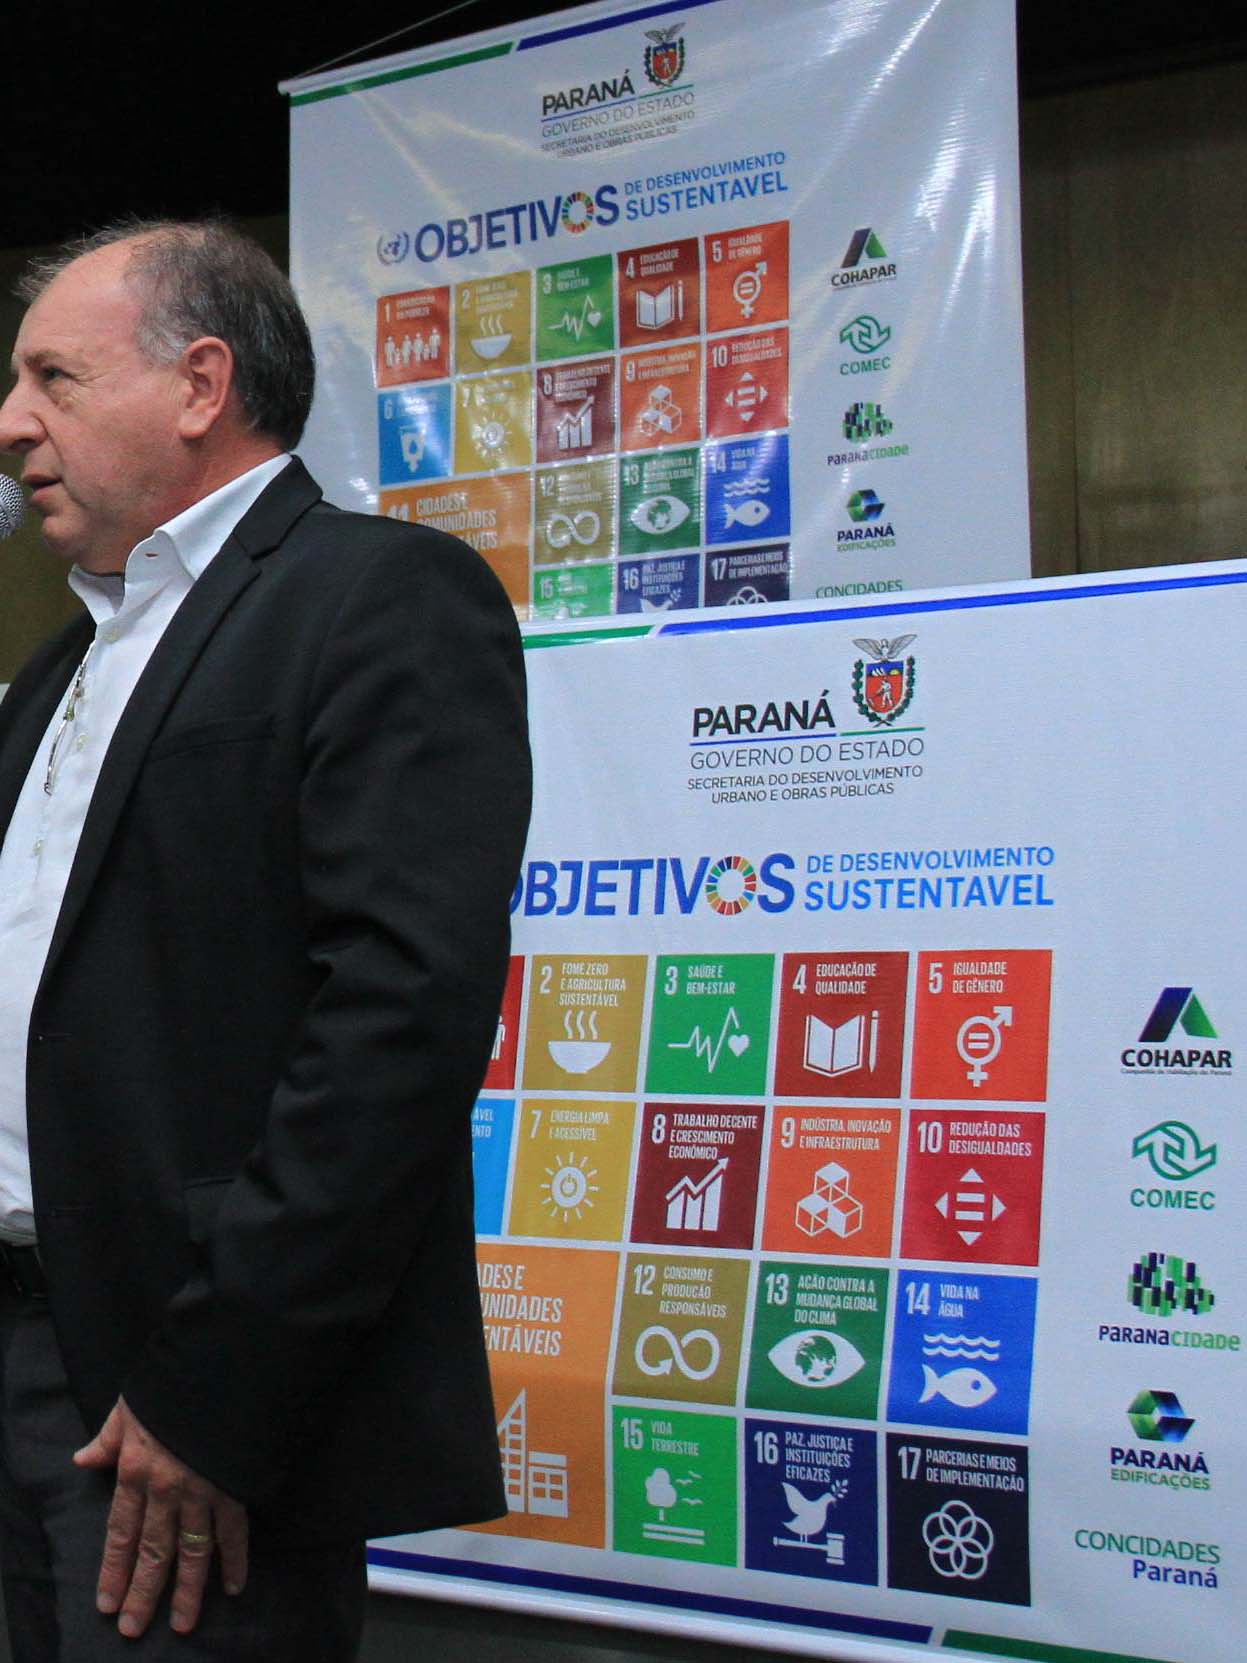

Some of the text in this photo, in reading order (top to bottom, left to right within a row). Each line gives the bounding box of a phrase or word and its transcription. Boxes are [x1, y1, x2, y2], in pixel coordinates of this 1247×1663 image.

[543, 69, 635, 116] PARANÁ
[542, 112, 609, 138] GOVERNO
[613, 106, 634, 121] DO
[638, 92, 694, 116] ESTADO
[624, 152, 786, 196] DE DESENVOLVIMENTO
[625, 172, 789, 220] SUSTENTAVEL
[414, 185, 621, 263] OBJETIVOS
[712, 240, 722, 262] 5
[625, 257, 635, 279] 4
[831, 264, 896, 286] COHAPAR
[543, 273, 551, 294] 3
[462, 290, 470, 308] 2
[712, 345, 728, 367] 10
[840, 357, 891, 375] COMEC
[626, 361, 636, 381] 9
[543, 374, 552, 395] 8
[624, 464, 639, 485] 13
[837, 522, 894, 541] PARANÁ
[624, 568, 639, 590] 16
[712, 558, 727, 580] 17
[816, 579, 903, 598] CONCIDADES
[693, 689, 836, 737] PARANÁ
[690, 737, 924, 770] GOVERNO DO ESTADO
[687, 765, 923, 789] SECRETARIA DO DESENVOLVIMENTO
[711, 783, 894, 804] URBANO E OBRAS PÚBLICAS
[806, 846, 1055, 873] DE DESENVOLVIMENTO
[804, 873, 1055, 911] SUSTENTAVEL
[562, 963, 609, 975] FOME ZERO
[687, 965, 723, 977] SAÚDE E
[793, 964, 807, 994] 4
[816, 961, 876, 977] EDUCAÇÃO DE
[929, 963, 944, 993] 5
[953, 961, 1007, 976] IGUALDADE
[540, 965, 552, 994] 2
[560, 978, 626, 990] E AGRICULTURA
[664, 966, 678, 995] 3
[686, 982, 736, 995] BEM-ESTAR
[815, 981, 867, 994] QUALIDADE
[952, 978, 1003, 993] DE GÊNERO
[559, 991, 619, 1006] SUSTENTÁVEL
[1121, 1049, 1232, 1068] COHAPAR
[530, 1110, 542, 1139] 7
[583, 1111, 610, 1125] LIMPA
[673, 1113, 758, 1128] TRABALHO DECENTE
[847, 1119, 892, 1134] INOVAÇÃO
[652, 1114, 666, 1144] 8
[670, 1130, 735, 1144] E CRESCIMENTO
[781, 1117, 796, 1148] 9
[918, 1121, 942, 1153] 10
[950, 1121, 1020, 1138] REDUÇÃO DAS
[669, 1145, 718, 1160] ECONÔMICO
[799, 1136, 879, 1150] E INFRAESTRUTURA
[949, 1140, 1031, 1157] DESIGUALDADES
[1130, 1188, 1216, 1211] COMEC
[514, 1265, 525, 1291] E
[634, 1264, 656, 1296] 12
[663, 1266, 713, 1281] CONSUMO E
[798, 1274, 875, 1293] AÇÃO CONTRA A
[662, 1284, 711, 1300] PRODUÇÃO
[765, 1272, 789, 1306] 13
[906, 1281, 930, 1316] 14
[940, 1284, 979, 1300] VIDA NA
[481, 1294, 563, 1323] UNIDADES
[659, 1300, 727, 1318] RESPONSÁVEIS
[796, 1292, 878, 1312] MUDANÇA GLOBAL
[939, 1302, 964, 1318] ÁGUA
[794, 1310, 836, 1326] DO CLIMA
[483, 1324, 561, 1356] NTÁVEIS
[621, 1418, 644, 1450] 15
[651, 1420, 672, 1435] VIDA
[651, 1438, 699, 1456] TERRESTRE
[754, 1431, 778, 1465] 16
[807, 1434, 846, 1450] JUSTIÇA
[847, 1437, 853, 1451] E
[785, 1447, 851, 1468] INSTITUIÇÕES
[898, 1446, 921, 1480] 17
[926, 1448, 1017, 1472] PARCERIAS E MEIOS
[1110, 1446, 1209, 1474] PARANÁ
[785, 1465, 831, 1483] EFICAZES
[926, 1467, 1025, 1493] DE IMPLEMENTAÇÃO
[1111, 1469, 1210, 1490] EDIFICAÇÕES
[1075, 1529, 1221, 1565] CONCIDADES
[1132, 1559, 1218, 1589] Paraná
